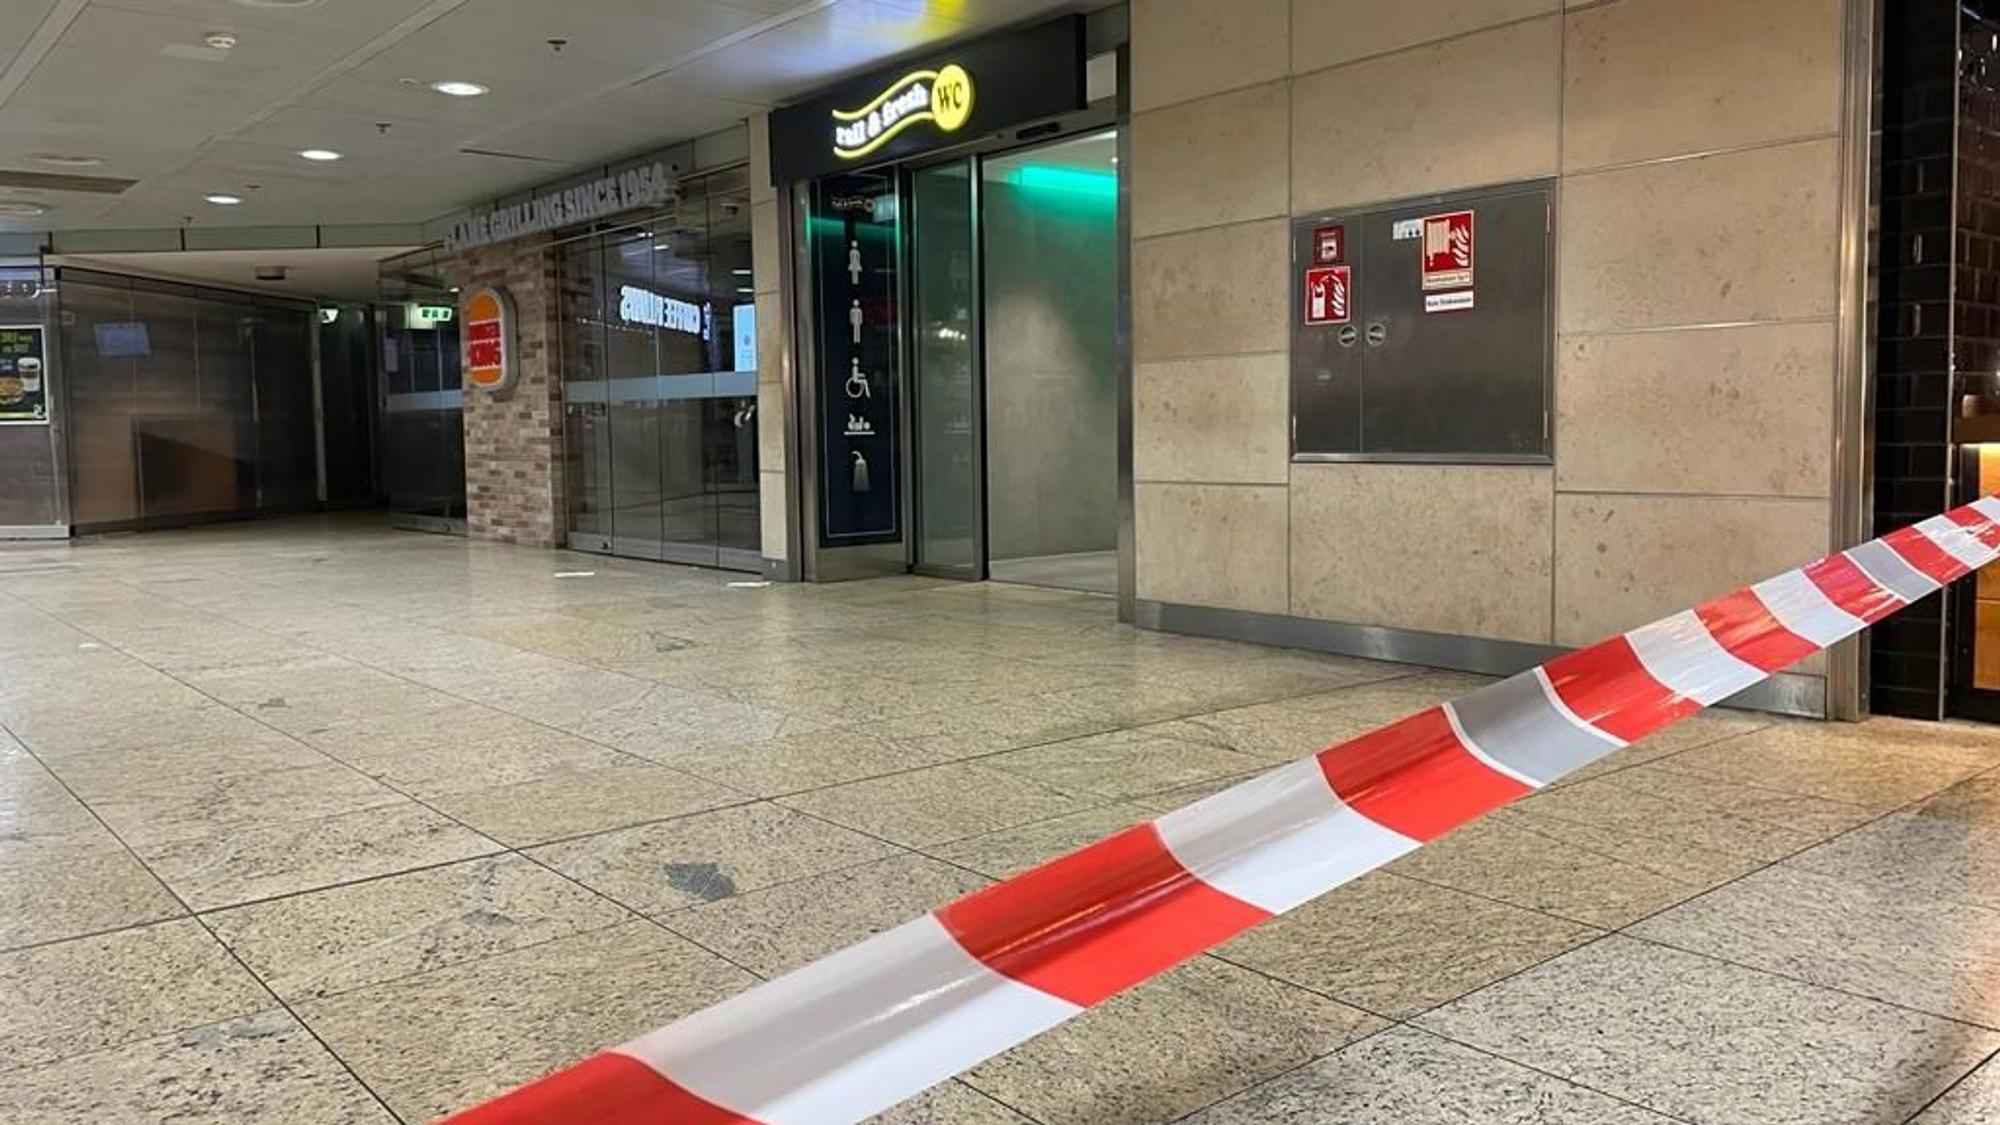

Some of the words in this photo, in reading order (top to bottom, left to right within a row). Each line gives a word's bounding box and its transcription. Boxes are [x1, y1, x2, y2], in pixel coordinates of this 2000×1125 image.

[937, 82, 962, 112] WC
[490, 193, 563, 243] GRILLING
[563, 177, 618, 221] SINCE
